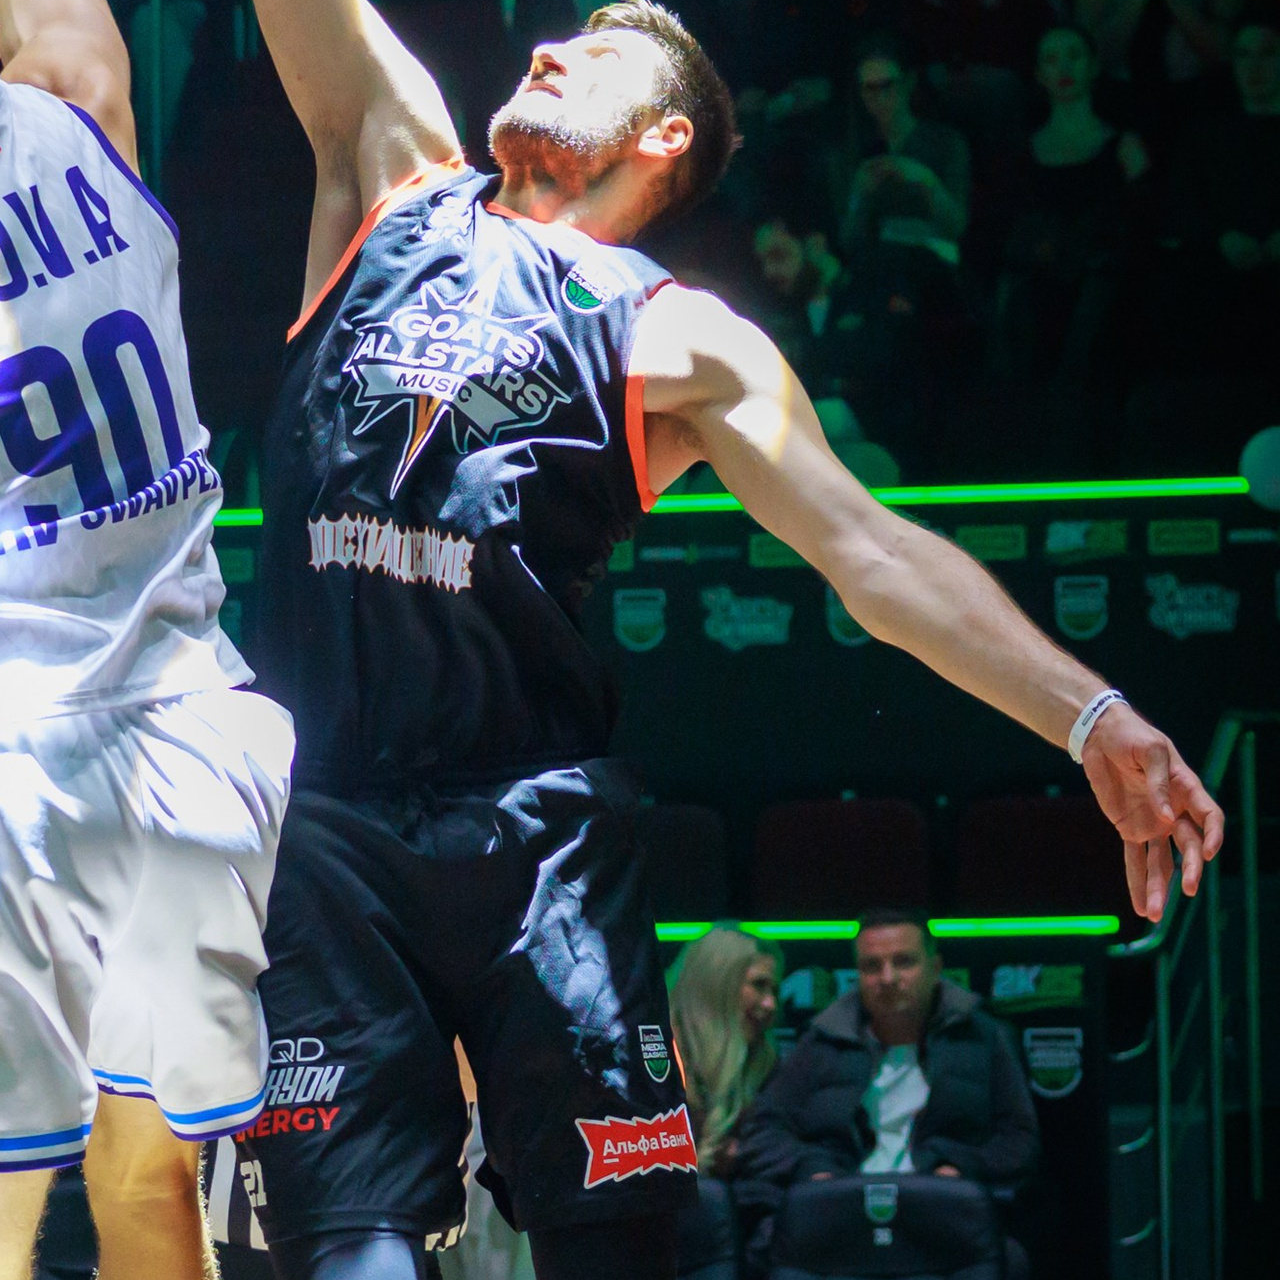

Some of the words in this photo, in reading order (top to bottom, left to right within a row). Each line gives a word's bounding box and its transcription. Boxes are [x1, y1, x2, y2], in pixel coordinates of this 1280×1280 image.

[397, 312, 535, 368] GOATS
[354, 332, 548, 415] ALLSTARS
[396, 372, 473, 404] MUSIC
[641, 1043, 667, 1052] MEDIA
[603, 1134, 660, 1159] Альфа
[660, 1131, 689, 1149] Банк
